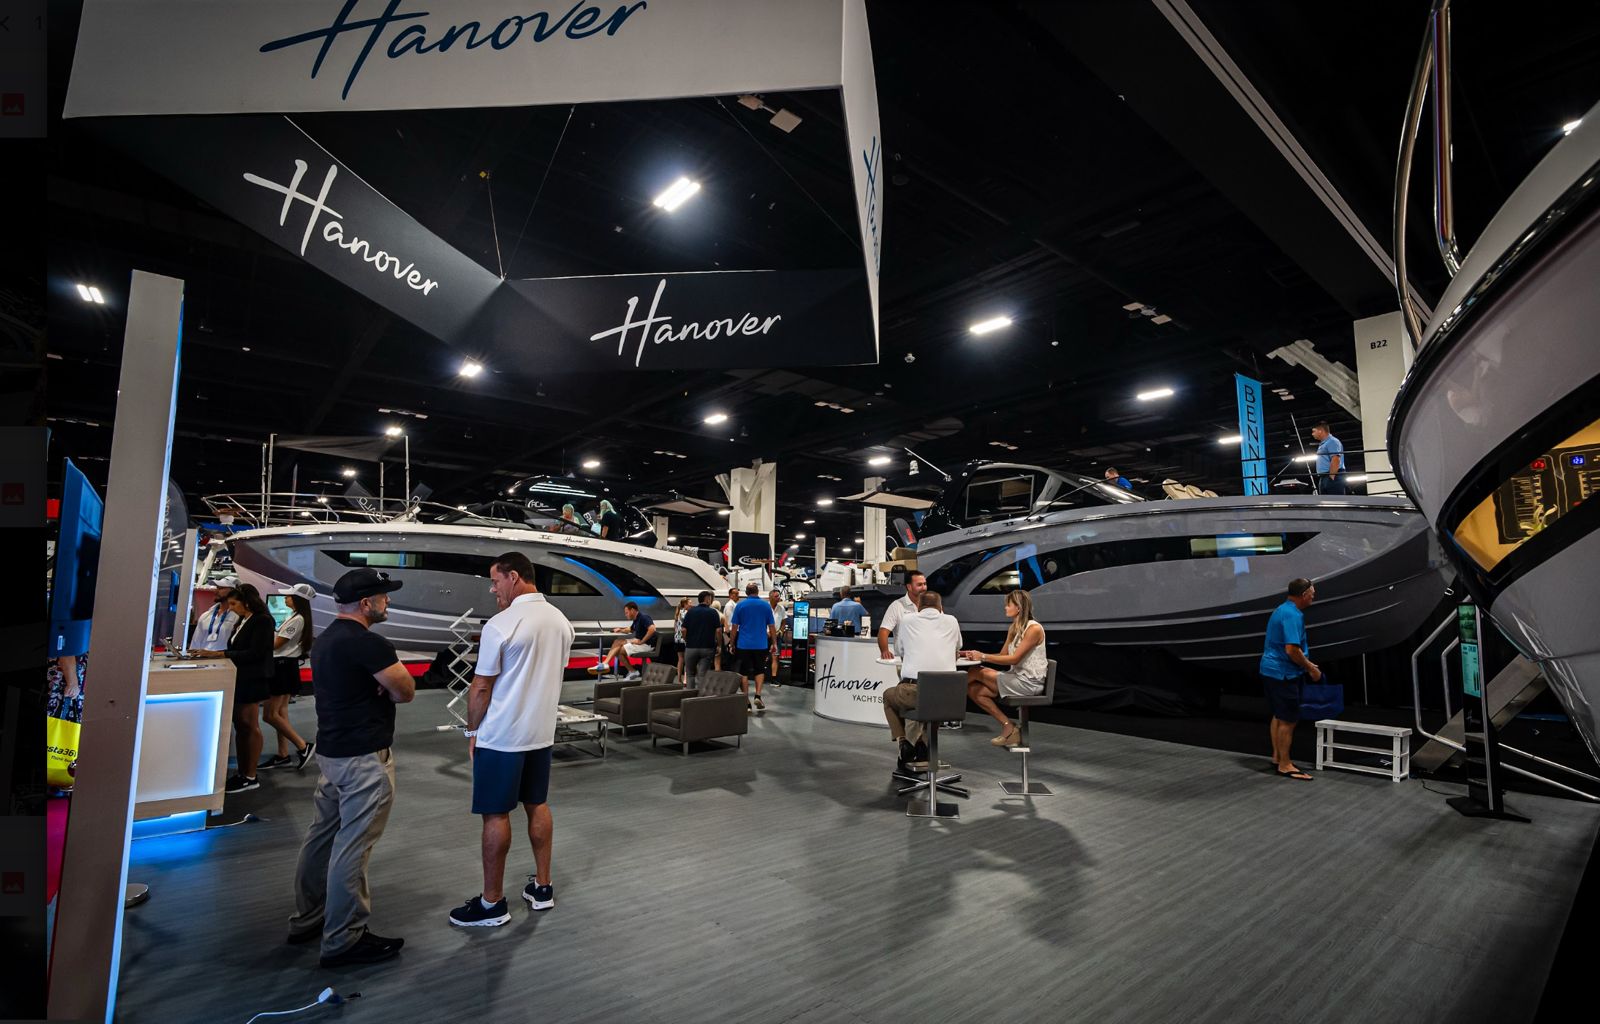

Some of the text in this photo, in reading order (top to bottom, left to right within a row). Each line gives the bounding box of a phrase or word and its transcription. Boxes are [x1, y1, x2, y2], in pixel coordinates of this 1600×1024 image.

[259, 0, 647, 101] Hanover
[243, 158, 439, 297] Hanover
[589, 278, 782, 368] Hanover
[1369, 338, 1388, 350] B22
[817, 657, 883, 700] Hanover
[852, 694, 883, 704] YACHTS
